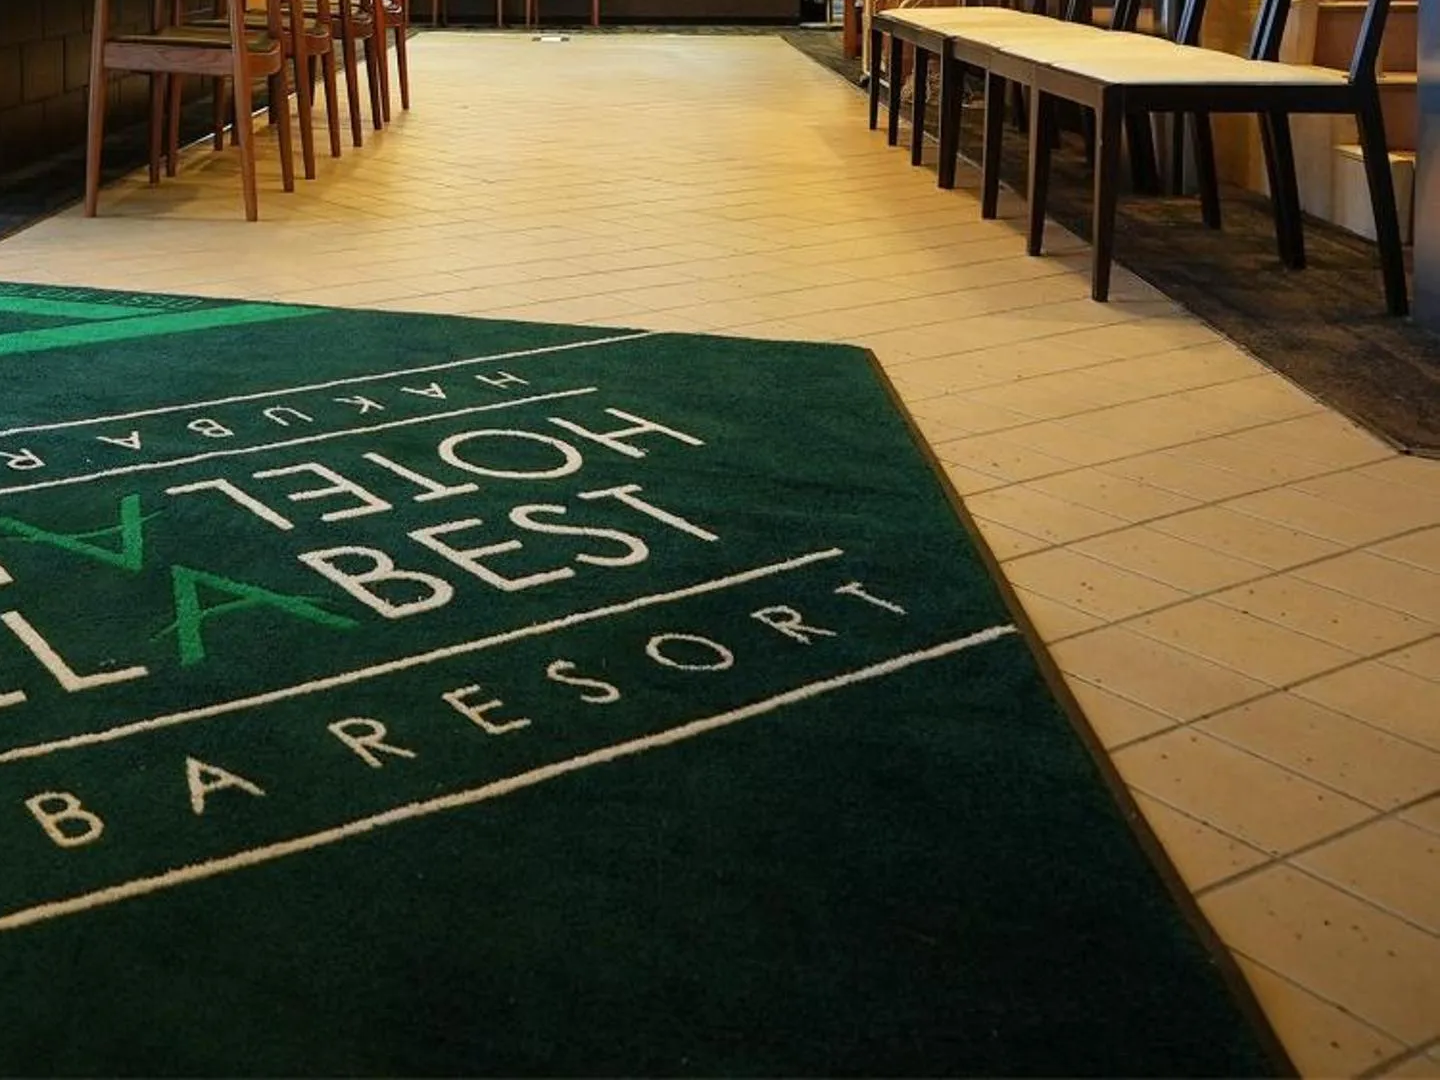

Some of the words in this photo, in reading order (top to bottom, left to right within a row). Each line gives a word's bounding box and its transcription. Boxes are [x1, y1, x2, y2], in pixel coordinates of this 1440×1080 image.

[97, 371, 529, 449] HAKUBA
[165, 407, 705, 530] HOTEL
[328, 581, 905, 767] RESORT
